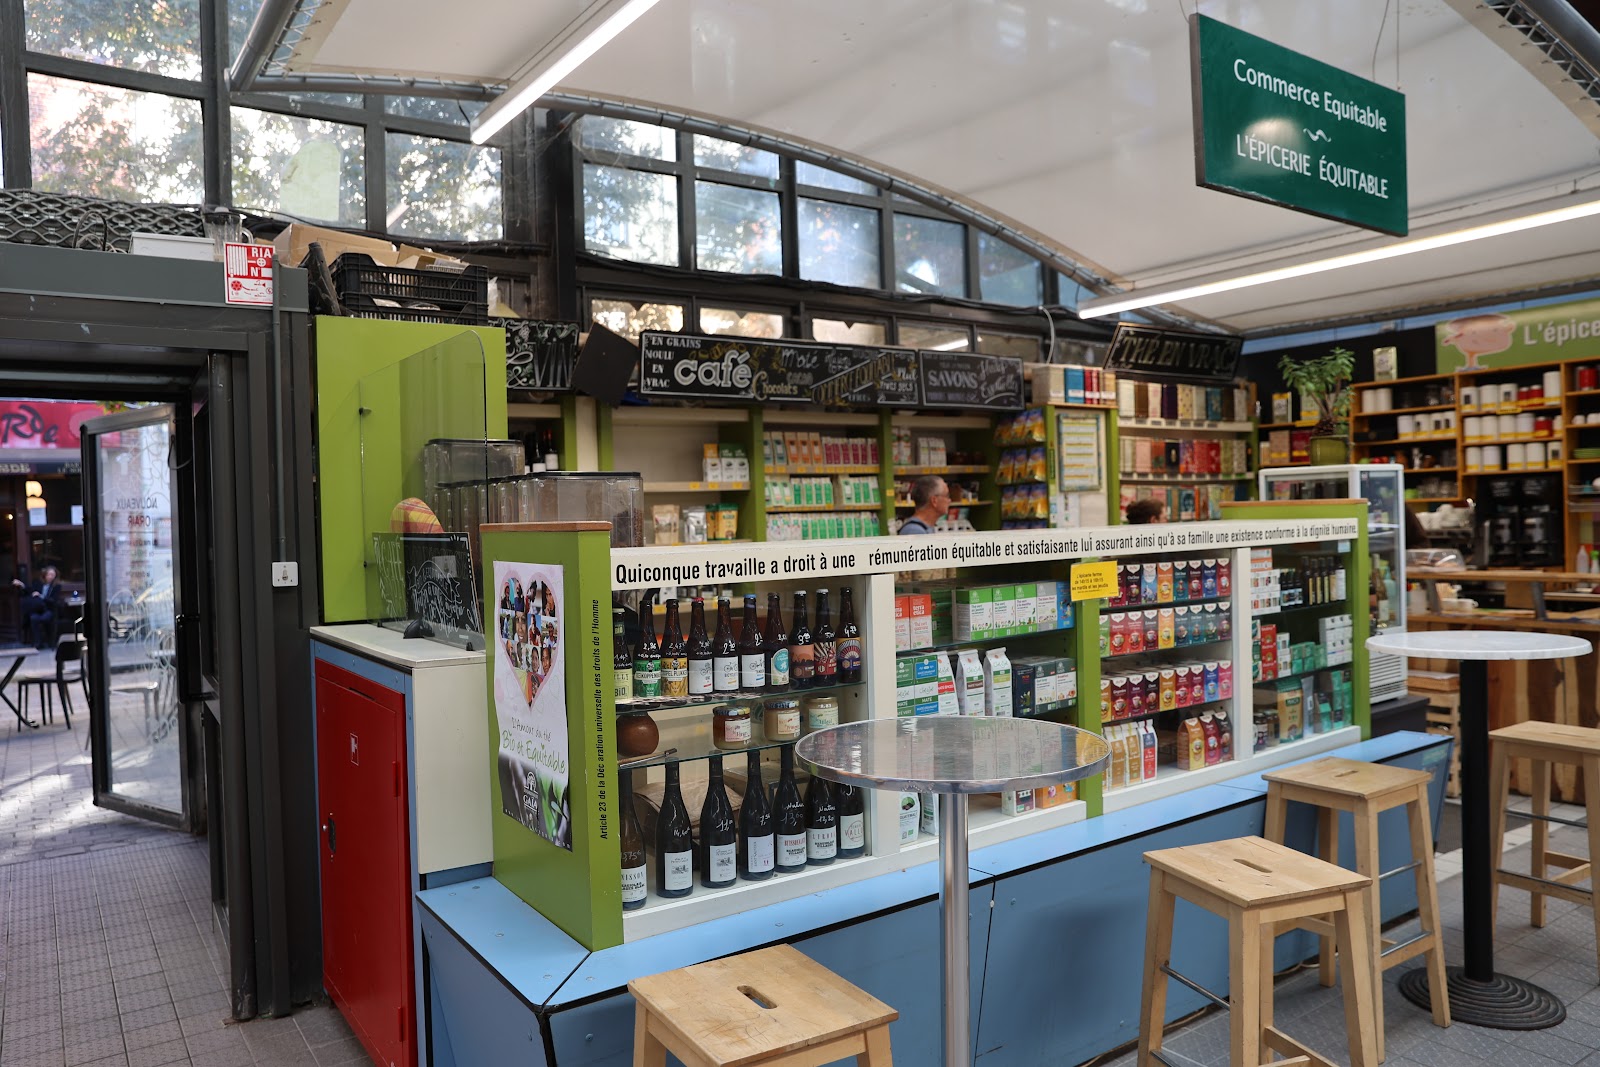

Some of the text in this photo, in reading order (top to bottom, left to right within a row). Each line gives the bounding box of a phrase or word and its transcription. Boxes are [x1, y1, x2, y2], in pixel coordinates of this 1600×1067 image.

[1234, 59, 1387, 132] Commerce Equitable
[1236, 134, 1389, 199] L'ÉPICERIE ÉQUITABLE
[252, 247, 272, 258] RIA
[652, 336, 701, 348] EN GRAINS
[645, 350, 674, 360] MOULU
[652, 364, 664, 373] EN
[674, 350, 751, 388] café
[646, 378, 670, 388] VRAC
[928, 370, 978, 389] SAVONS
[616, 564, 699, 584] Quiconque
[706, 558, 765, 578] travaille
[771, 560, 778, 573] a
[784, 554, 815, 572] droit
[820, 552, 827, 570] à
[833, 554, 855, 569] une
[869, 546, 948, 567] rémunération
[952, 542, 1001, 562] équitable
[1005, 542, 1015, 555] et
[1017, 539, 1078, 556] satisfaisante
[1081, 538, 1092, 551] lui
[1096, 536, 1133, 551] assurant
[1136, 533, 1155, 547] ainsi
[1158, 532, 1175, 549] qu'à
[1177, 534, 1186, 545] sa
[1188, 530, 1213, 544] famille
[1216, 532, 1229, 543] une
[1231, 529, 1263, 542] existence
[1265, 526, 1295, 540] conforme
[1302, 526, 1308, 537] la
[1310, 524, 1330, 539] dignité
[591, 600, 599, 634] l'Homme
[592, 636, 599, 646] de
[593, 690, 603, 732] universelle
[502, 730, 515, 750] Bio
[517, 741, 524, 756] et
[598, 790, 605, 799] de
[598, 802, 606, 811] 23
